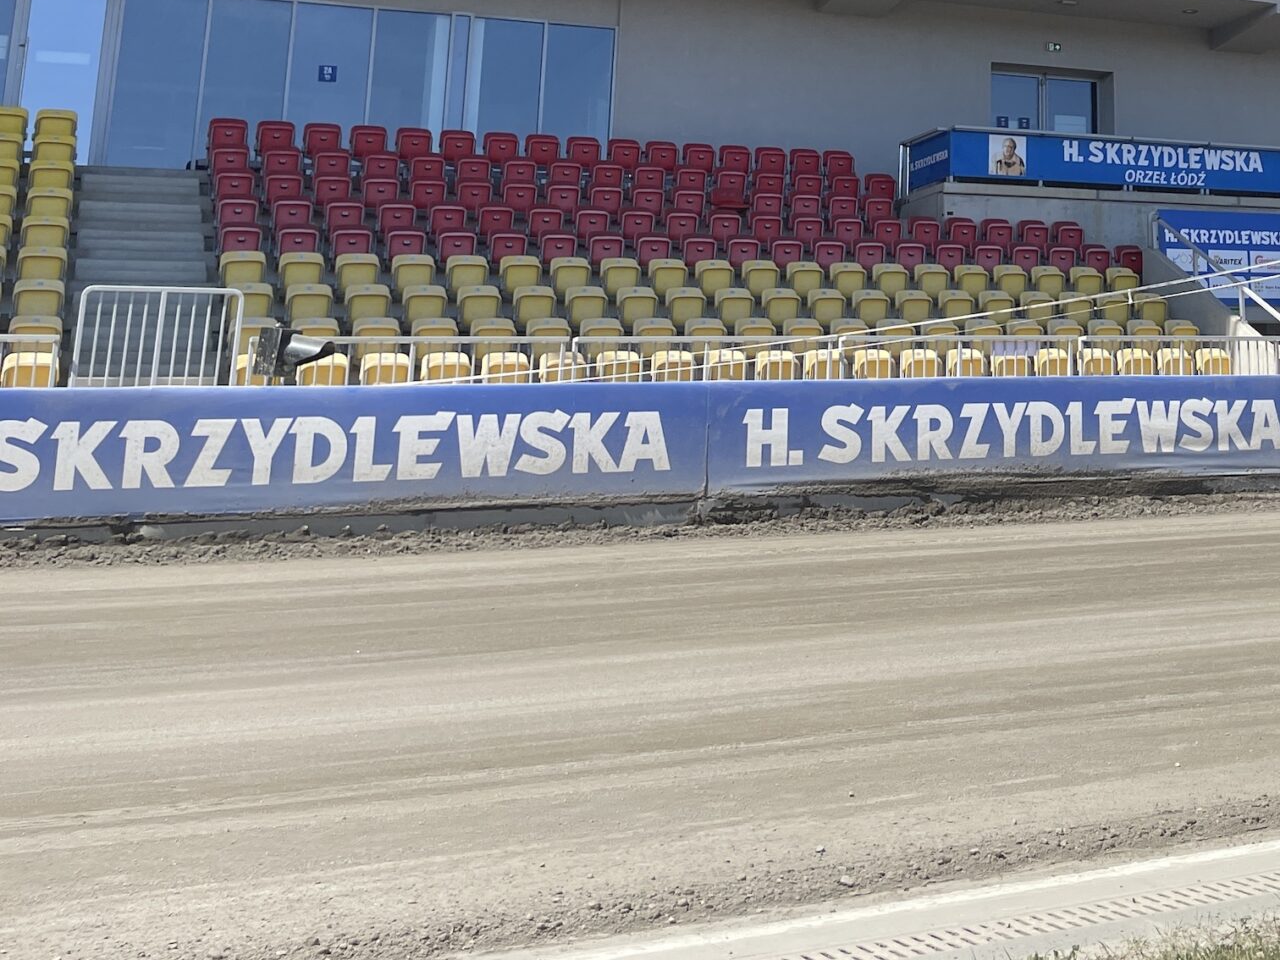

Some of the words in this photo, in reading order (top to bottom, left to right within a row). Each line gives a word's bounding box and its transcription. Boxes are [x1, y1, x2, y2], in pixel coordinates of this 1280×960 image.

[1063, 140, 1084, 163] H.
[1088, 142, 1263, 173] SKRZYDLEWSKA
[1125, 170, 1167, 185] ORZEŁ
[1170, 170, 1206, 186] ŁÓDŹ
[0, 411, 671, 491] SKRZYDLEWSKA
[743, 408, 803, 468] H.
